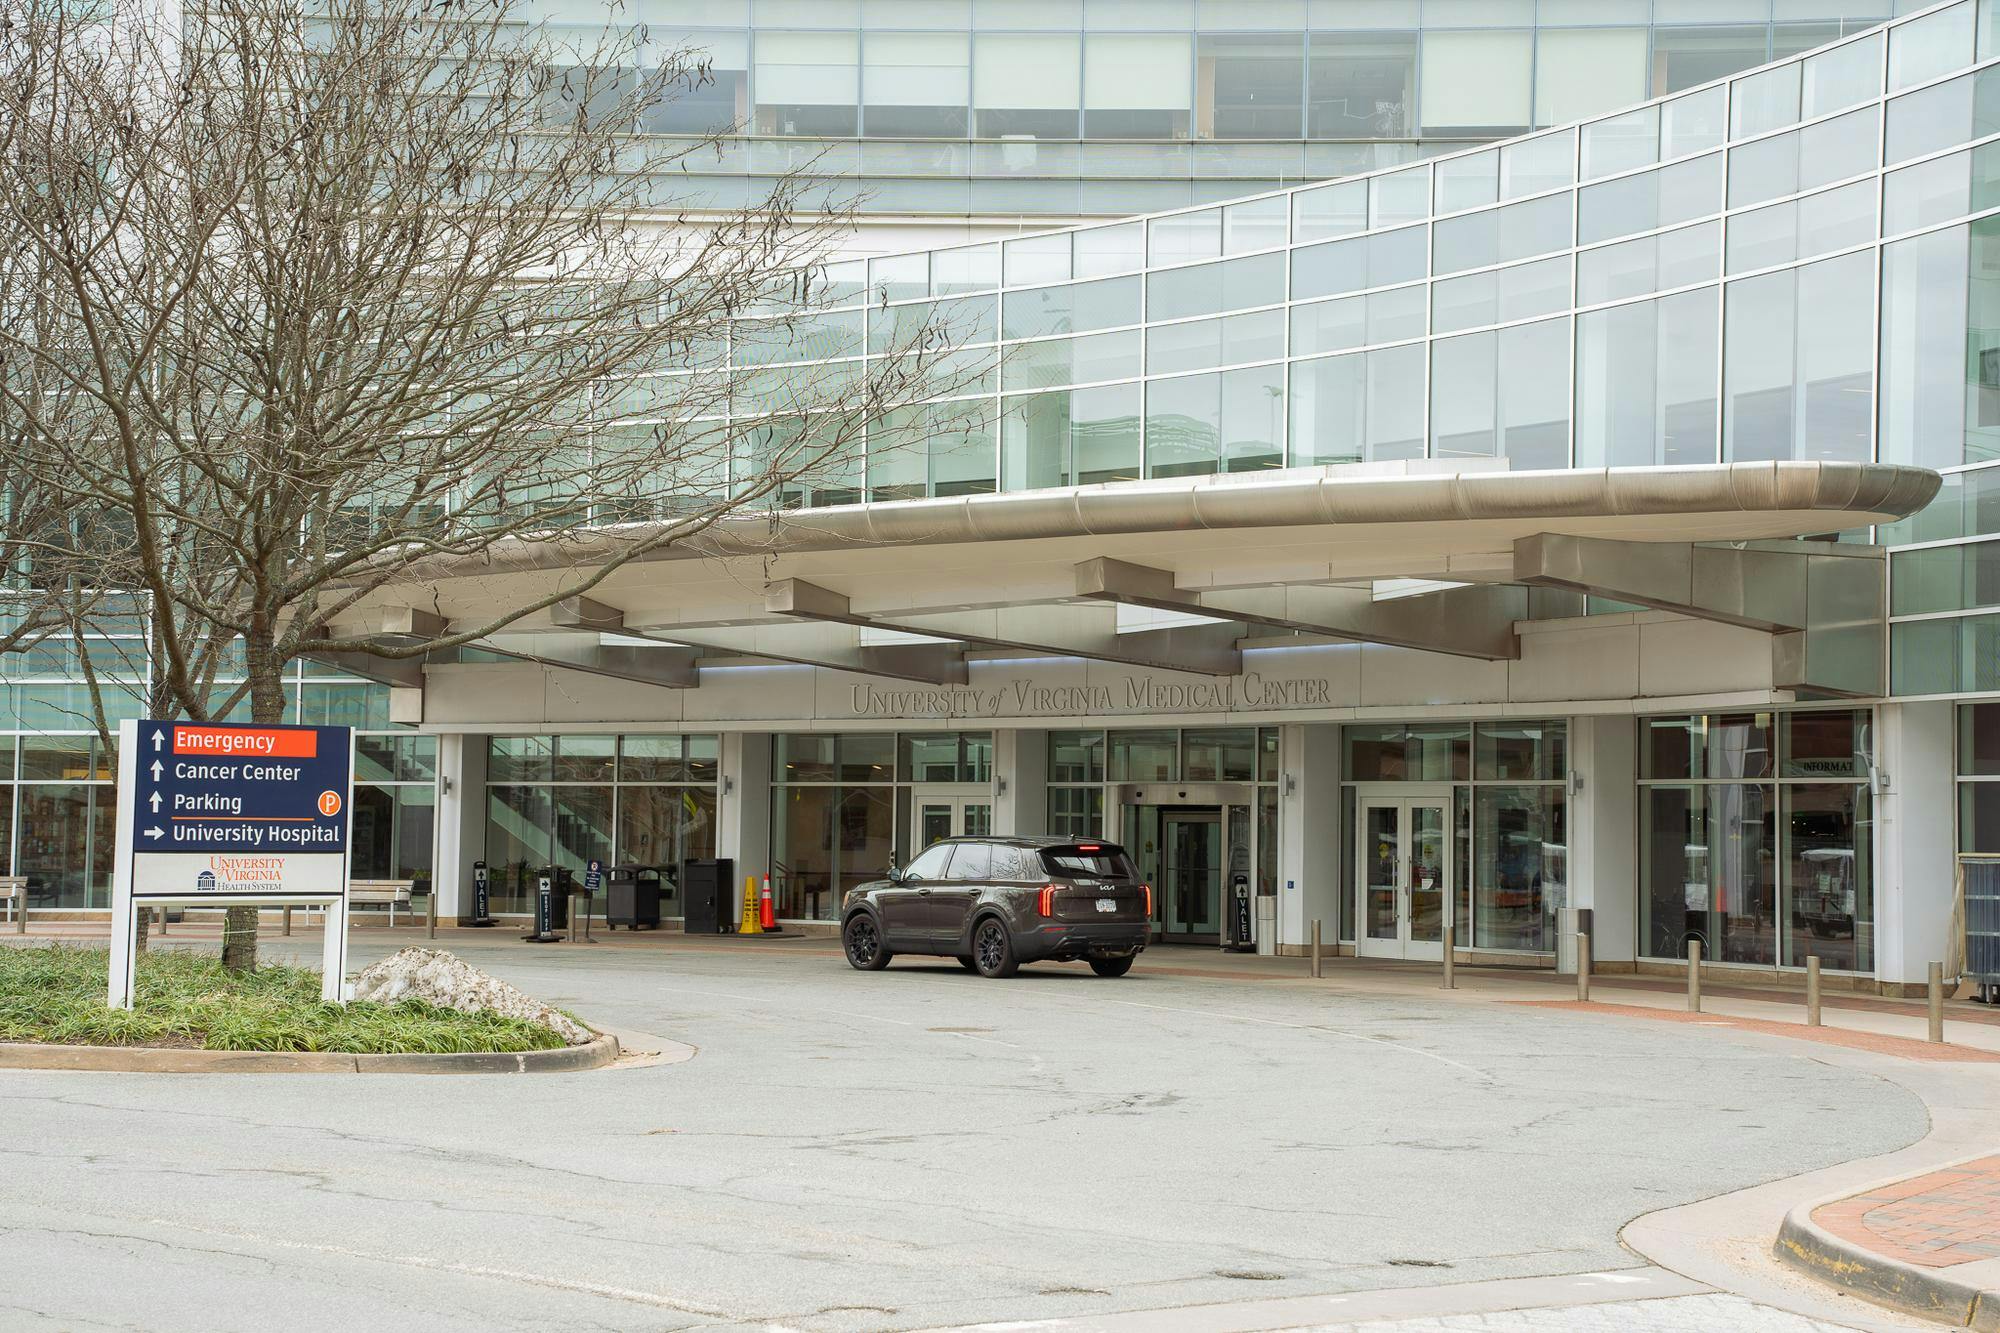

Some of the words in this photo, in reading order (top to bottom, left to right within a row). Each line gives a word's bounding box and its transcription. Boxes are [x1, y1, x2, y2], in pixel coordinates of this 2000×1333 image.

[849, 683, 984, 714] UNIVERSITY
[987, 687, 1007, 717] of
[1011, 680, 1114, 712] VIRGINIA
[1124, 675, 1237, 709] MEDICAL
[1243, 672, 1331, 706] CENTER
[176, 731, 276, 753] Emergency
[175, 762, 238, 779] Cancer
[242, 764, 301, 781] Center
[174, 793, 242, 815] Parking
[325, 794, 336, 813] P
[173, 824, 264, 845] University
[268, 825, 340, 846] Hospital
[210, 856, 285, 870] UNIVERSITY
[225, 868, 282, 881] VIRGINIA
[217, 882, 250, 891] HEALTH
[251, 881, 282, 891] SYSTEM
[478, 881, 486, 917] VALET
[1240, 899, 1248, 940] VALET
